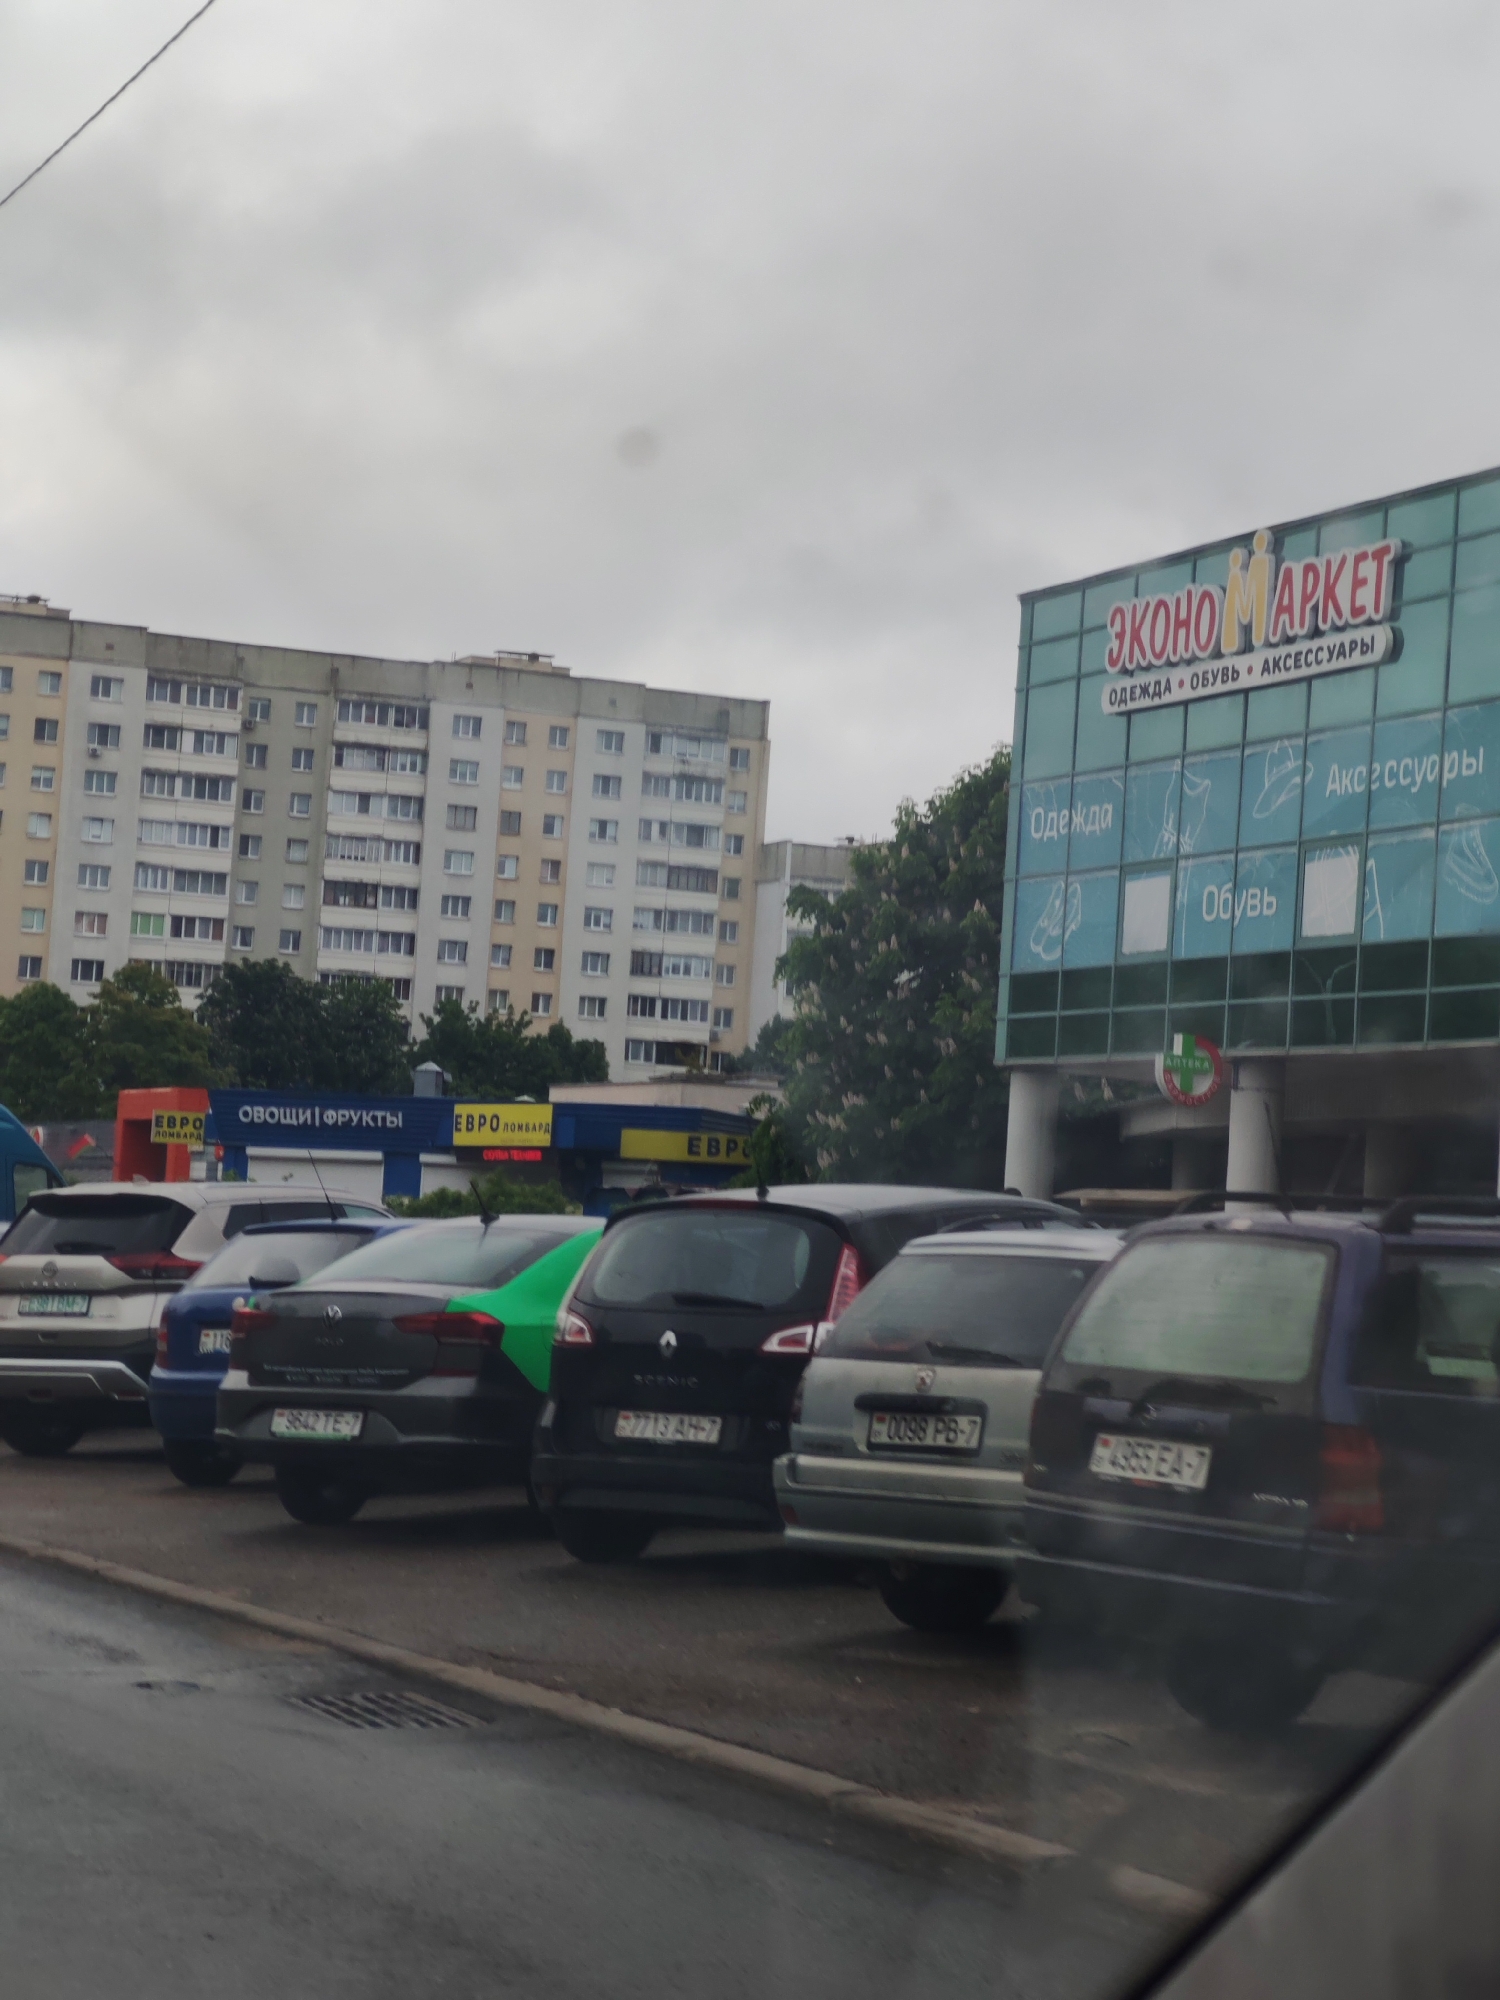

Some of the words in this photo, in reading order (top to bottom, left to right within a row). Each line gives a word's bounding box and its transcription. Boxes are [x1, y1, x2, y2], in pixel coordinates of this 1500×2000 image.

[1107, 532, 1392, 669] ЭКОНОМАРКЕТ
[1108, 678, 1172, 708] ОДЕЖДА
[1190, 663, 1240, 691] ОБУВЬ
[1260, 635, 1375, 677] АКСЕССУАРЫ
[1326, 746, 1484, 798] Аксессуары
[1030, 801, 1113, 842] Одежда
[1202, 881, 1278, 927] Обувь
[1165, 1056, 1209, 1070] АПТЕКА
[154, 1130, 202, 1142] ЛОМБАРД
[155, 1114, 203, 1131] ЕВРО
[455, 1112, 500, 1134] ЕВРО
[503, 1122, 551, 1136] ЛОМБАРД
[887, 1415, 929, 1442] 0098
